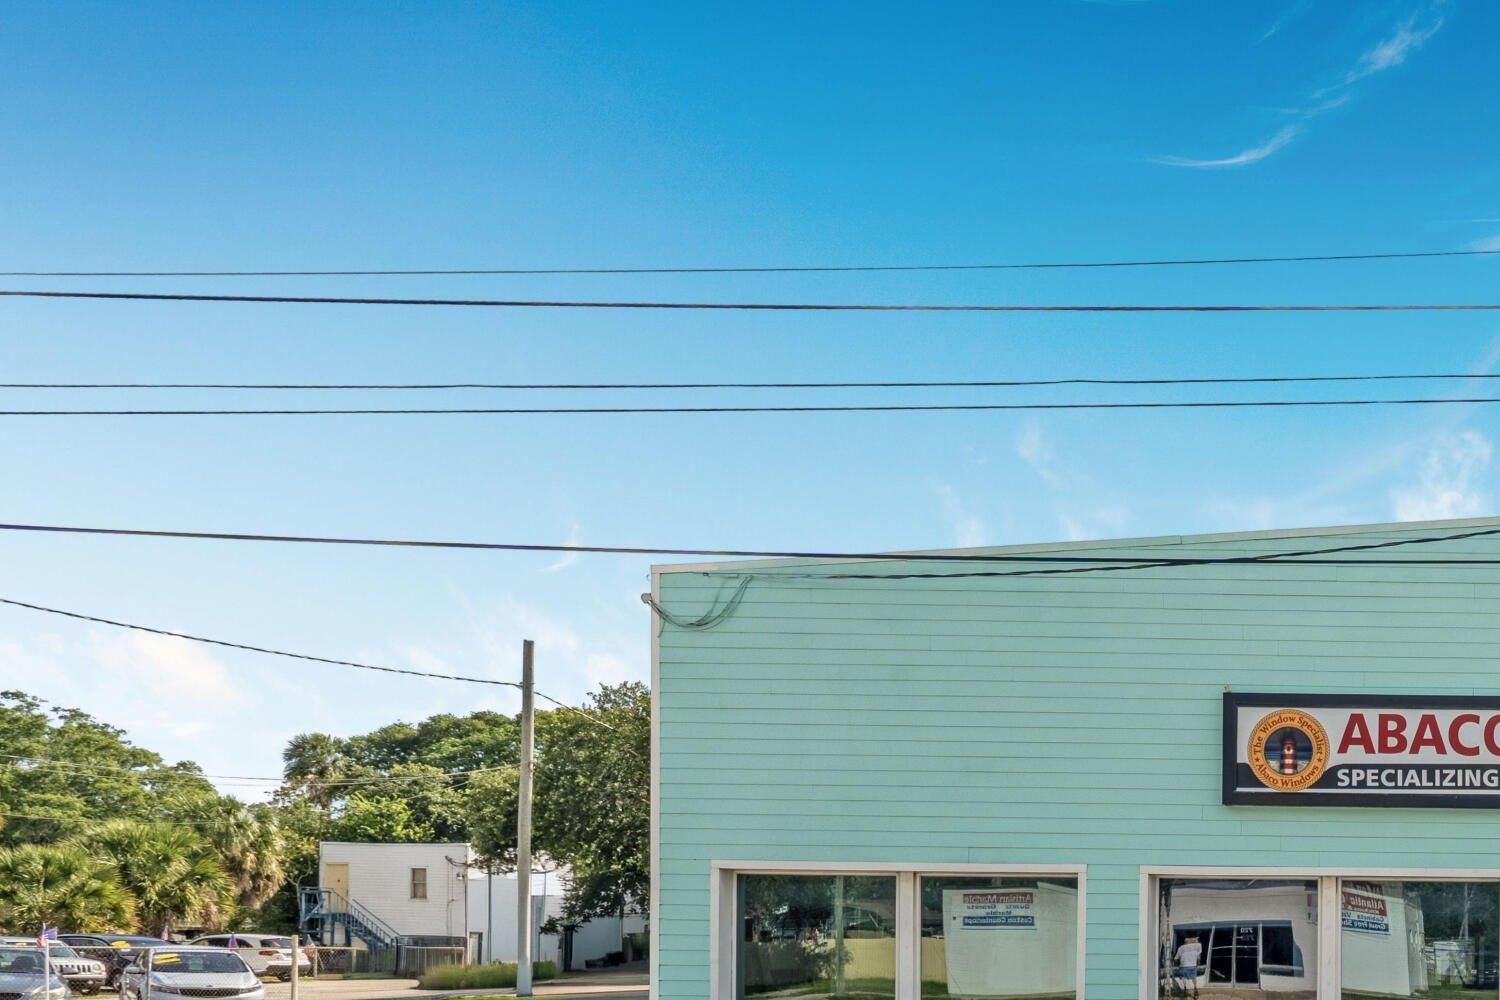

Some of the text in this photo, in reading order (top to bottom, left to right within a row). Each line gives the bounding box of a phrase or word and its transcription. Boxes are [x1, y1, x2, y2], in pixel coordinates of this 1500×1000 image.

[1254, 716, 1325, 755] The Window Specialist
[1256, 764, 1319, 788] Abaco Windows
[1337, 769, 1499, 787] SPECIALIZING
